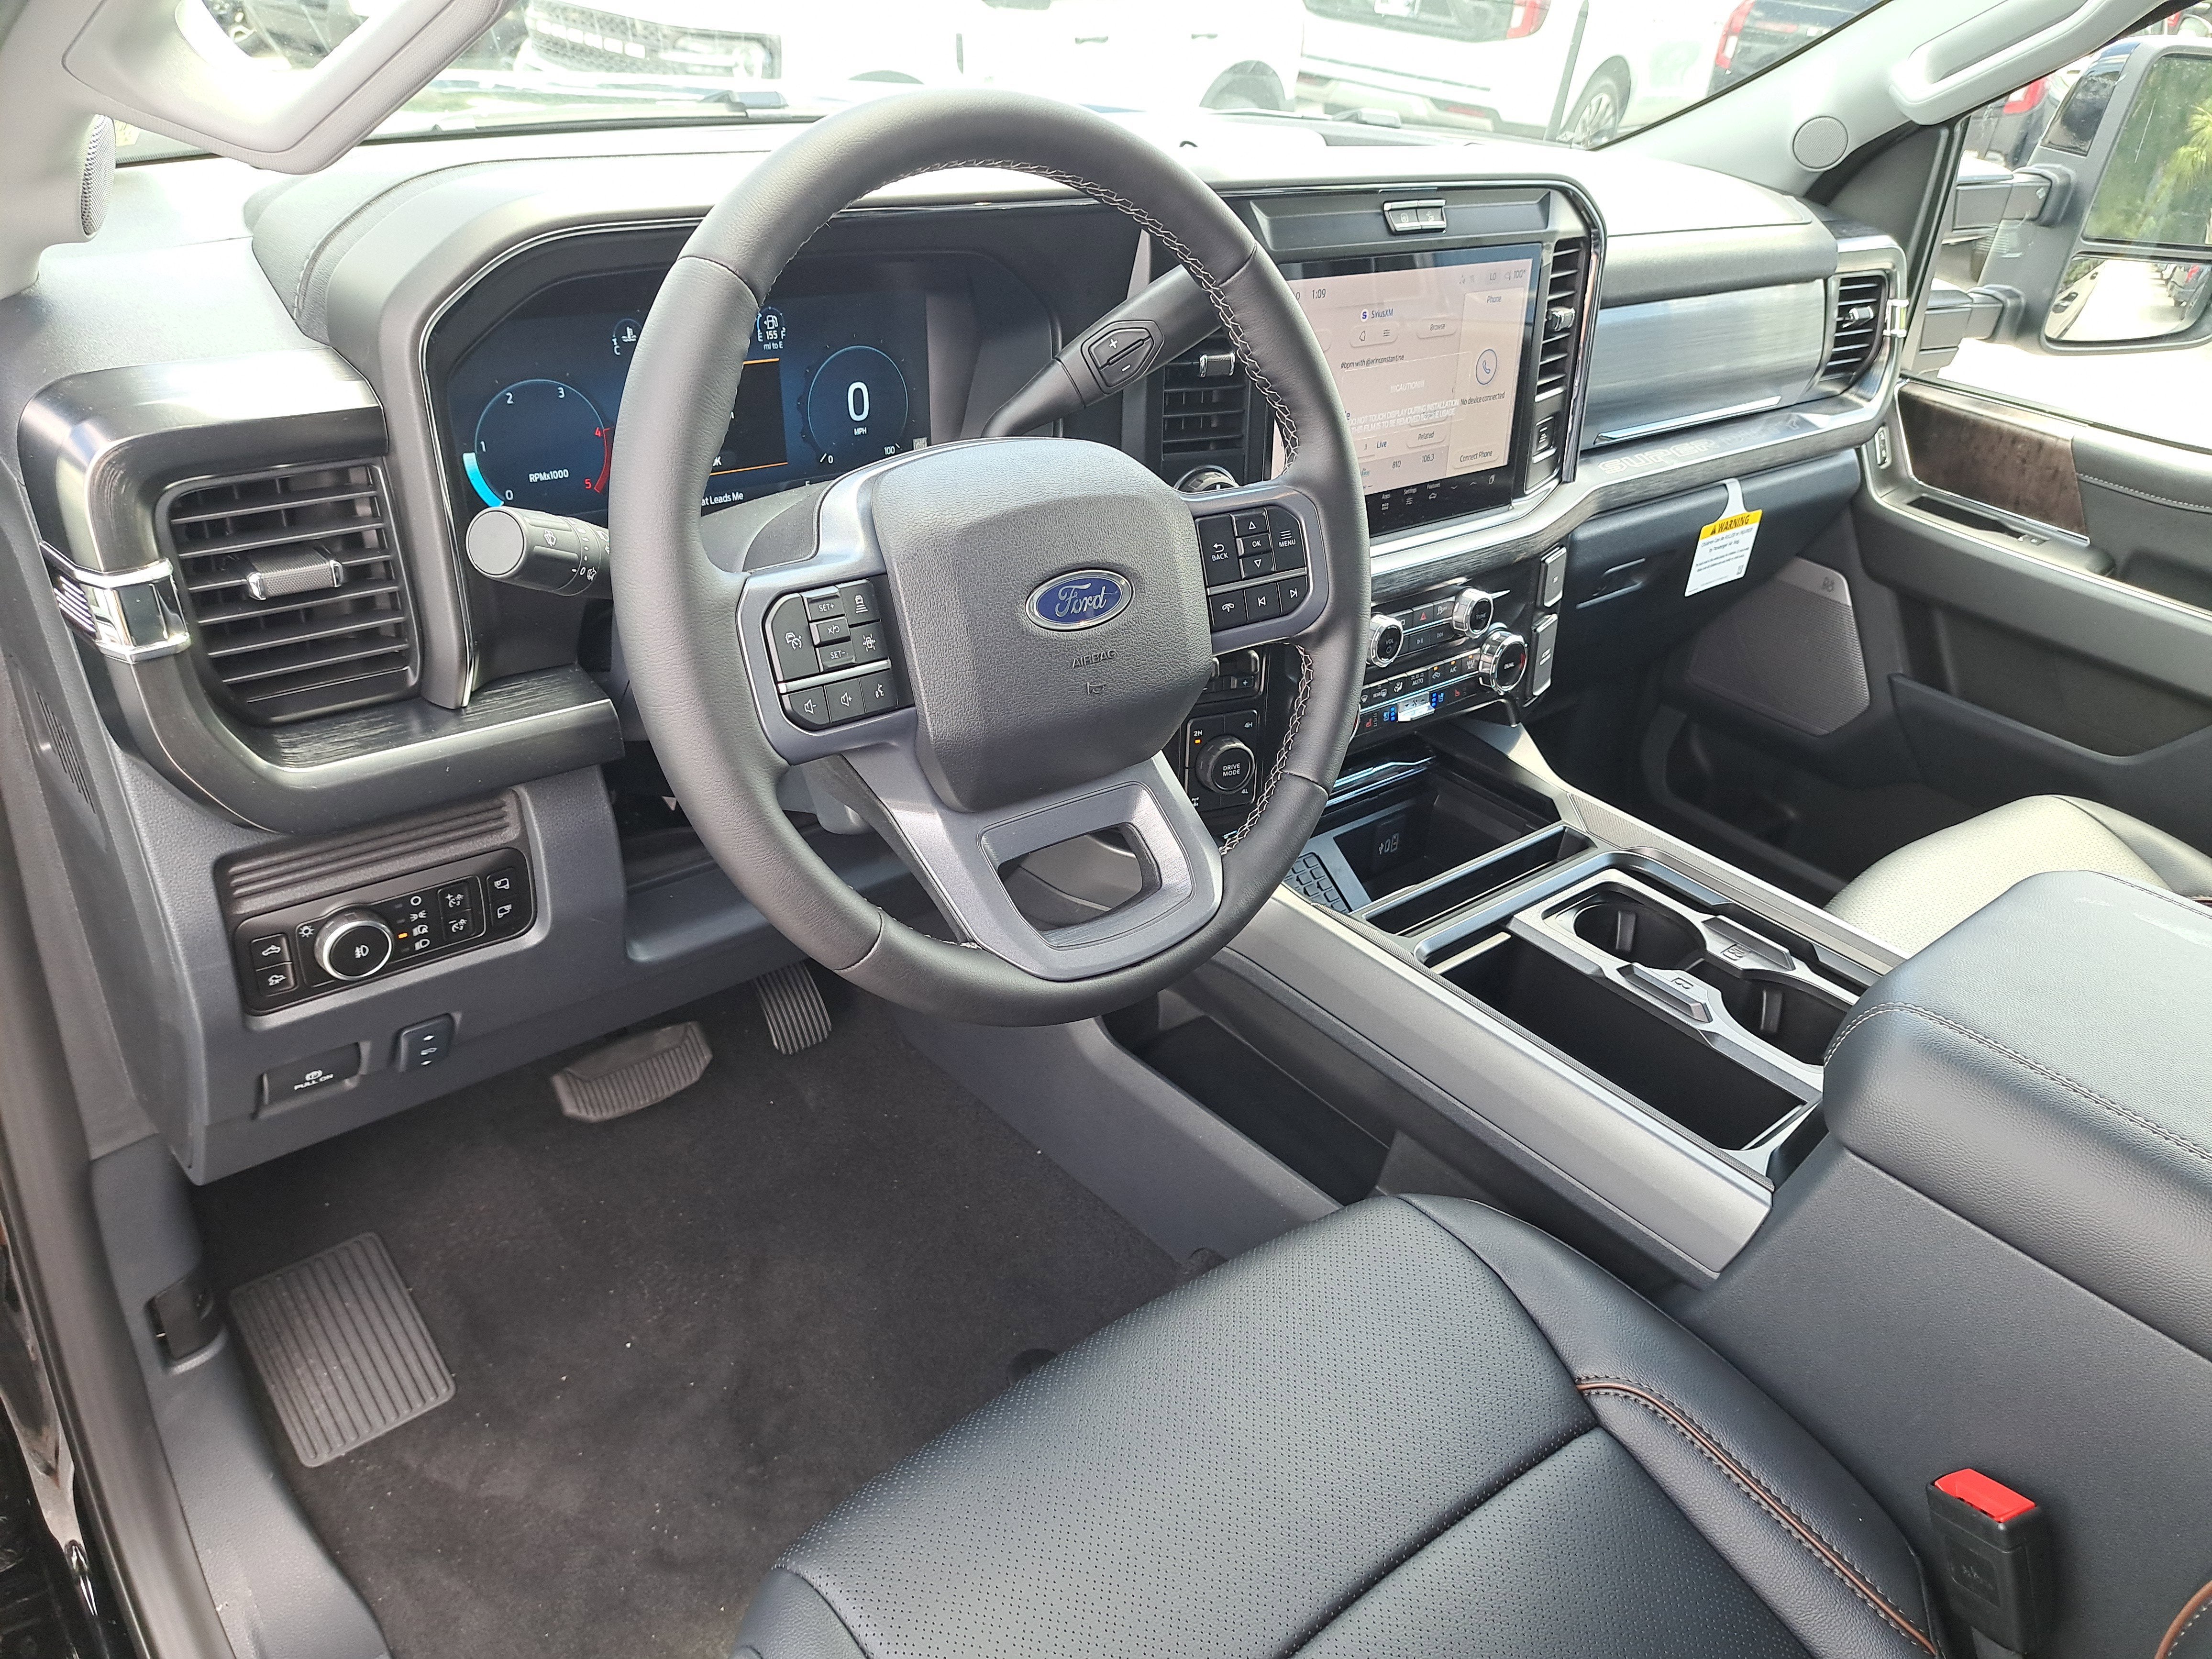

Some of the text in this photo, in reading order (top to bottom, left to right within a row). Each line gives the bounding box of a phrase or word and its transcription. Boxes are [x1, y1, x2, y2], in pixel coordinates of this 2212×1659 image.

[1312, 288, 1326, 299] 1:09
[1371, 309, 1394, 319] SiriusXM
[758, 330, 786, 342] E 155 F
[614, 345, 621, 355] C
[779, 341, 784, 349] E
[557, 387, 565, 398] 3
[506, 392, 514, 405] 2
[846, 381, 871, 422] 0
[1468, 396, 1482, 404] device
[1482, 392, 1505, 403] connected
[595, 427, 601, 437] 4
[854, 426, 867, 436] MPH
[1418, 431, 1434, 440] Related
[480, 441, 487, 452] 1
[884, 445, 896, 455] 100
[1377, 441, 1387, 449] Live
[828, 454, 834, 464] 0
[1460, 450, 1493, 462] Connect Phone
[1597, 438, 1720, 475] SUPER
[1392, 461, 1401, 469] 810
[529, 469, 569, 483] RPMx1000
[585, 478, 592, 489] 5
[505, 489, 514, 501] 0
[709, 493, 731, 505] Leads
[732, 491, 744, 501] Me
[1717, 514, 1750, 533] WARNING
[1279, 539, 1296, 548] MENU
[1212, 553, 1228, 561] BACK
[1055, 583, 1119, 618] Ford
[818, 604, 835, 612] SET+
[830, 651, 846, 660] SET-
[1072, 650, 1118, 669] AIRBAG
[1412, 678, 1424, 686] AUTO
[1222, 763, 1240, 771] DRIVE
[1222, 769, 1240, 777] MODE
[319, 1073, 334, 1082] ON
